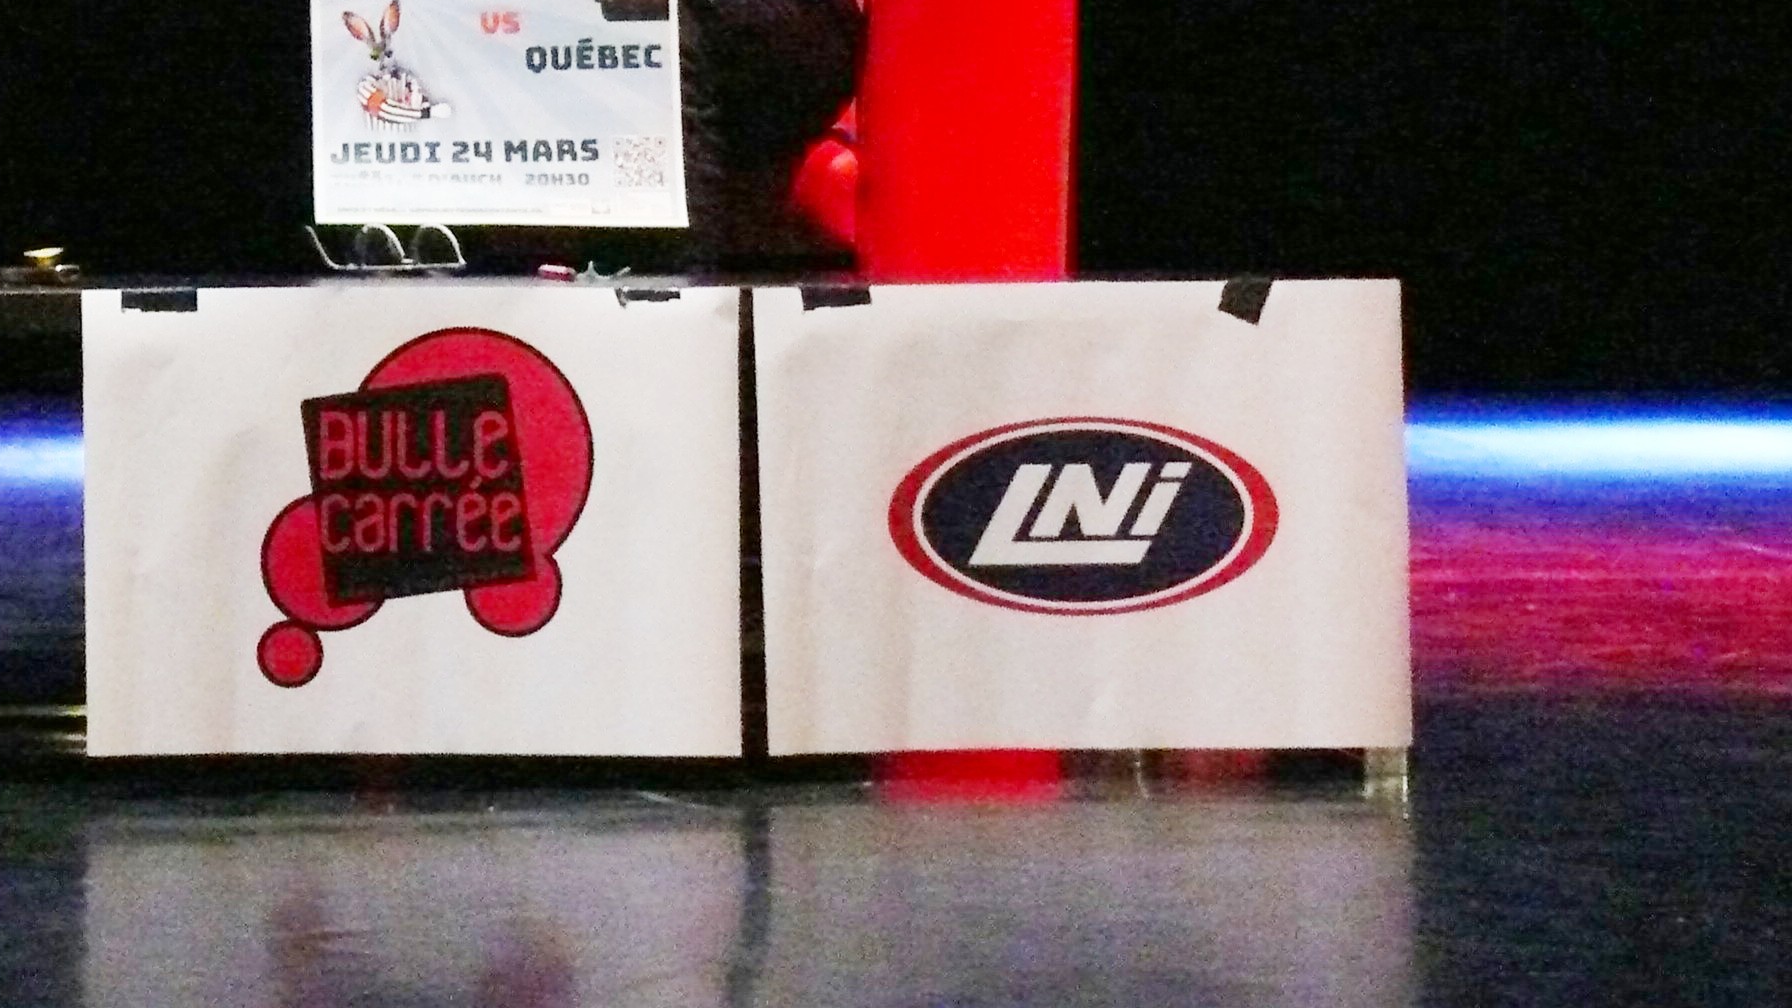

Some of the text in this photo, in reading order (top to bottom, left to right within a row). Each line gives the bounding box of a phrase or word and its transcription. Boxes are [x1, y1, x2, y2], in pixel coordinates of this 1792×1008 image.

[480, 11, 521, 34] VS
[525, 37, 662, 73] QUÉBEC
[332, 138, 600, 164] JEUDI 24 MARS
[525, 172, 590, 186] 20H30
[321, 476, 522, 553] carrée
